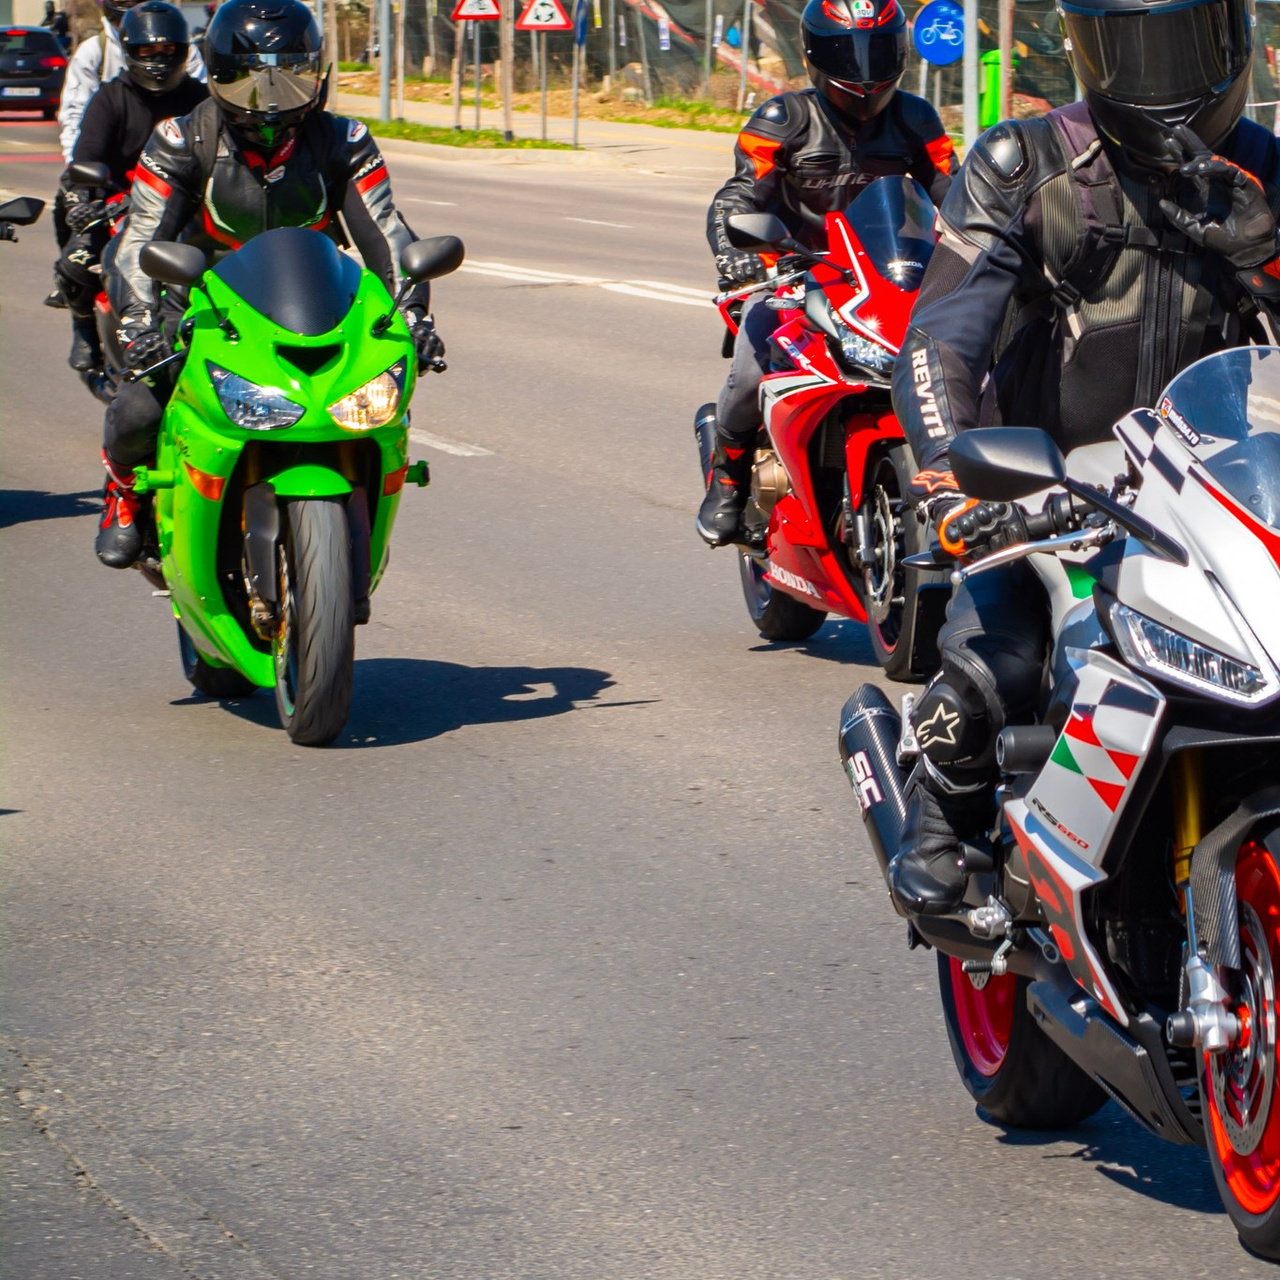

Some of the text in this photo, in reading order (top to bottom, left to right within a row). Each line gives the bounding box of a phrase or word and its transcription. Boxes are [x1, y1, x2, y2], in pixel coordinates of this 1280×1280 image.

[801, 171, 882, 189] DAINE
[714, 199, 727, 252] DAINESE
[912, 348, 946, 438] REV'IT!
[769, 560, 822, 599] HONDA
